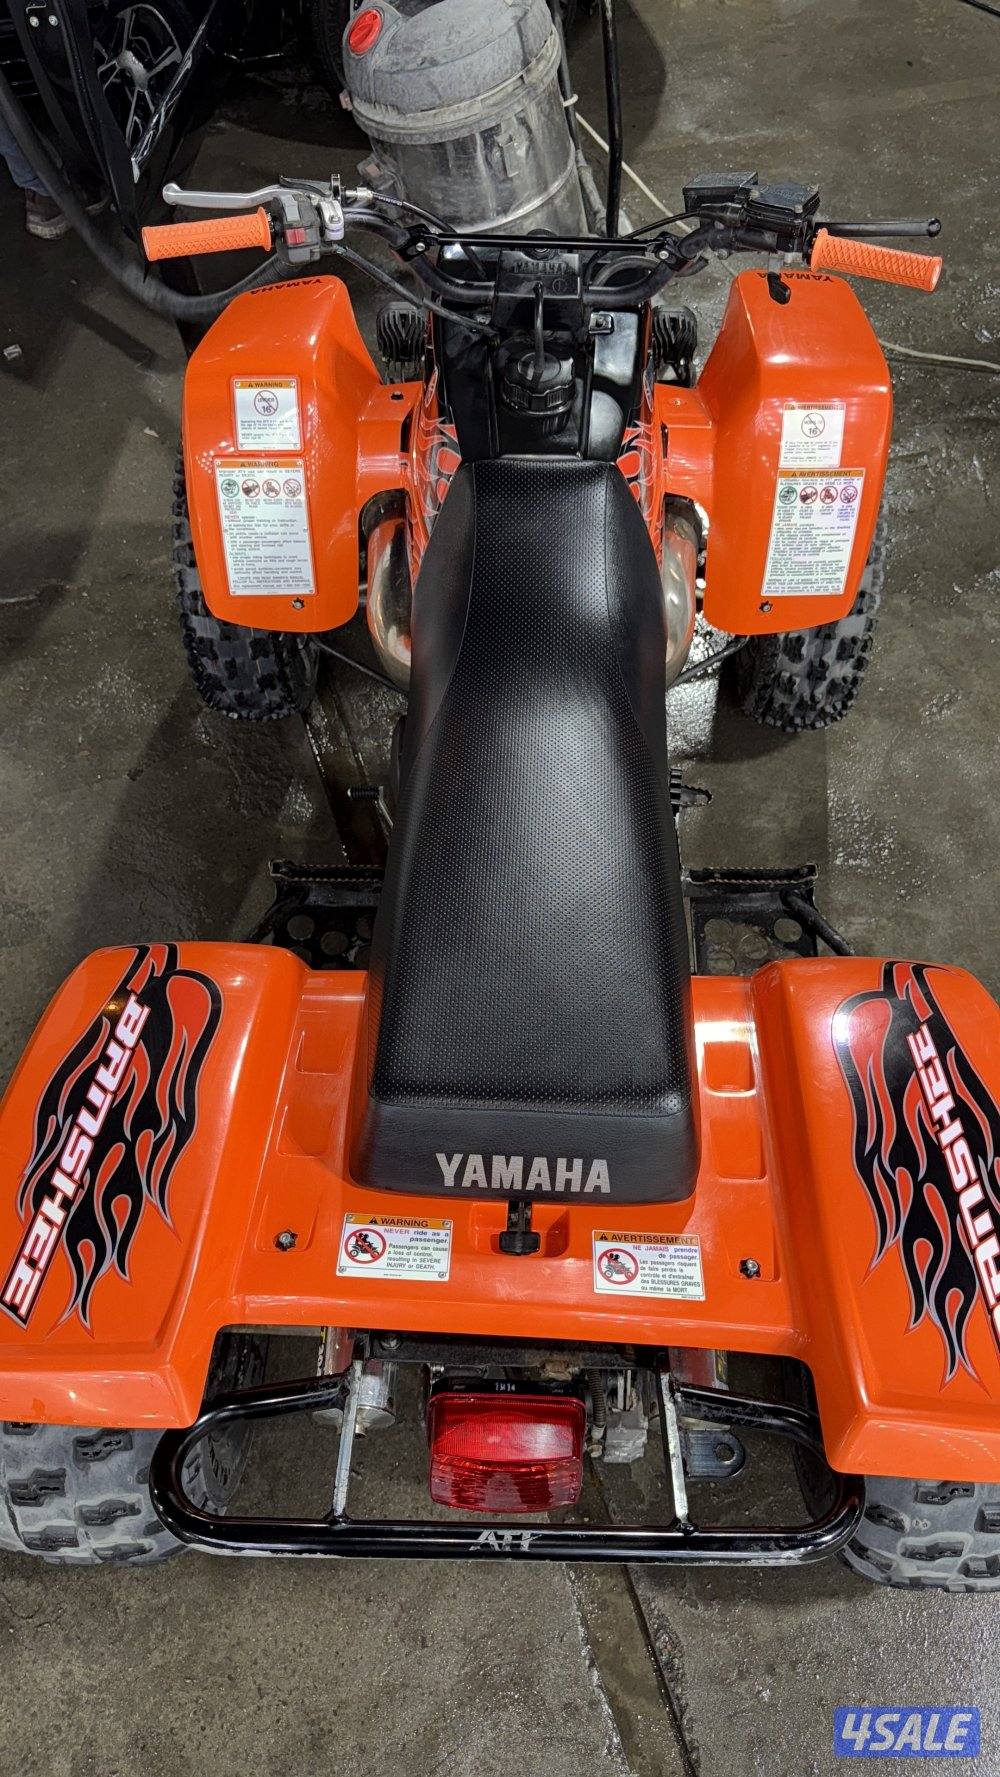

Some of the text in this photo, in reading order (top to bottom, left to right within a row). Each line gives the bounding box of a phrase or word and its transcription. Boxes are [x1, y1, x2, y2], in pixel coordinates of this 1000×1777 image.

[250, 279, 322, 295] YAMAHA
[4, 993, 151, 1319] BANSHEE
[435, 1152, 611, 1194] YAMAHA
[381, 1218, 428, 1228] WARNING
[384, 1227, 410, 1235] NEVER
[611, 1234, 695, 1245] AVERTISSEMENT
[388, 1243, 419, 1251] Passengers
